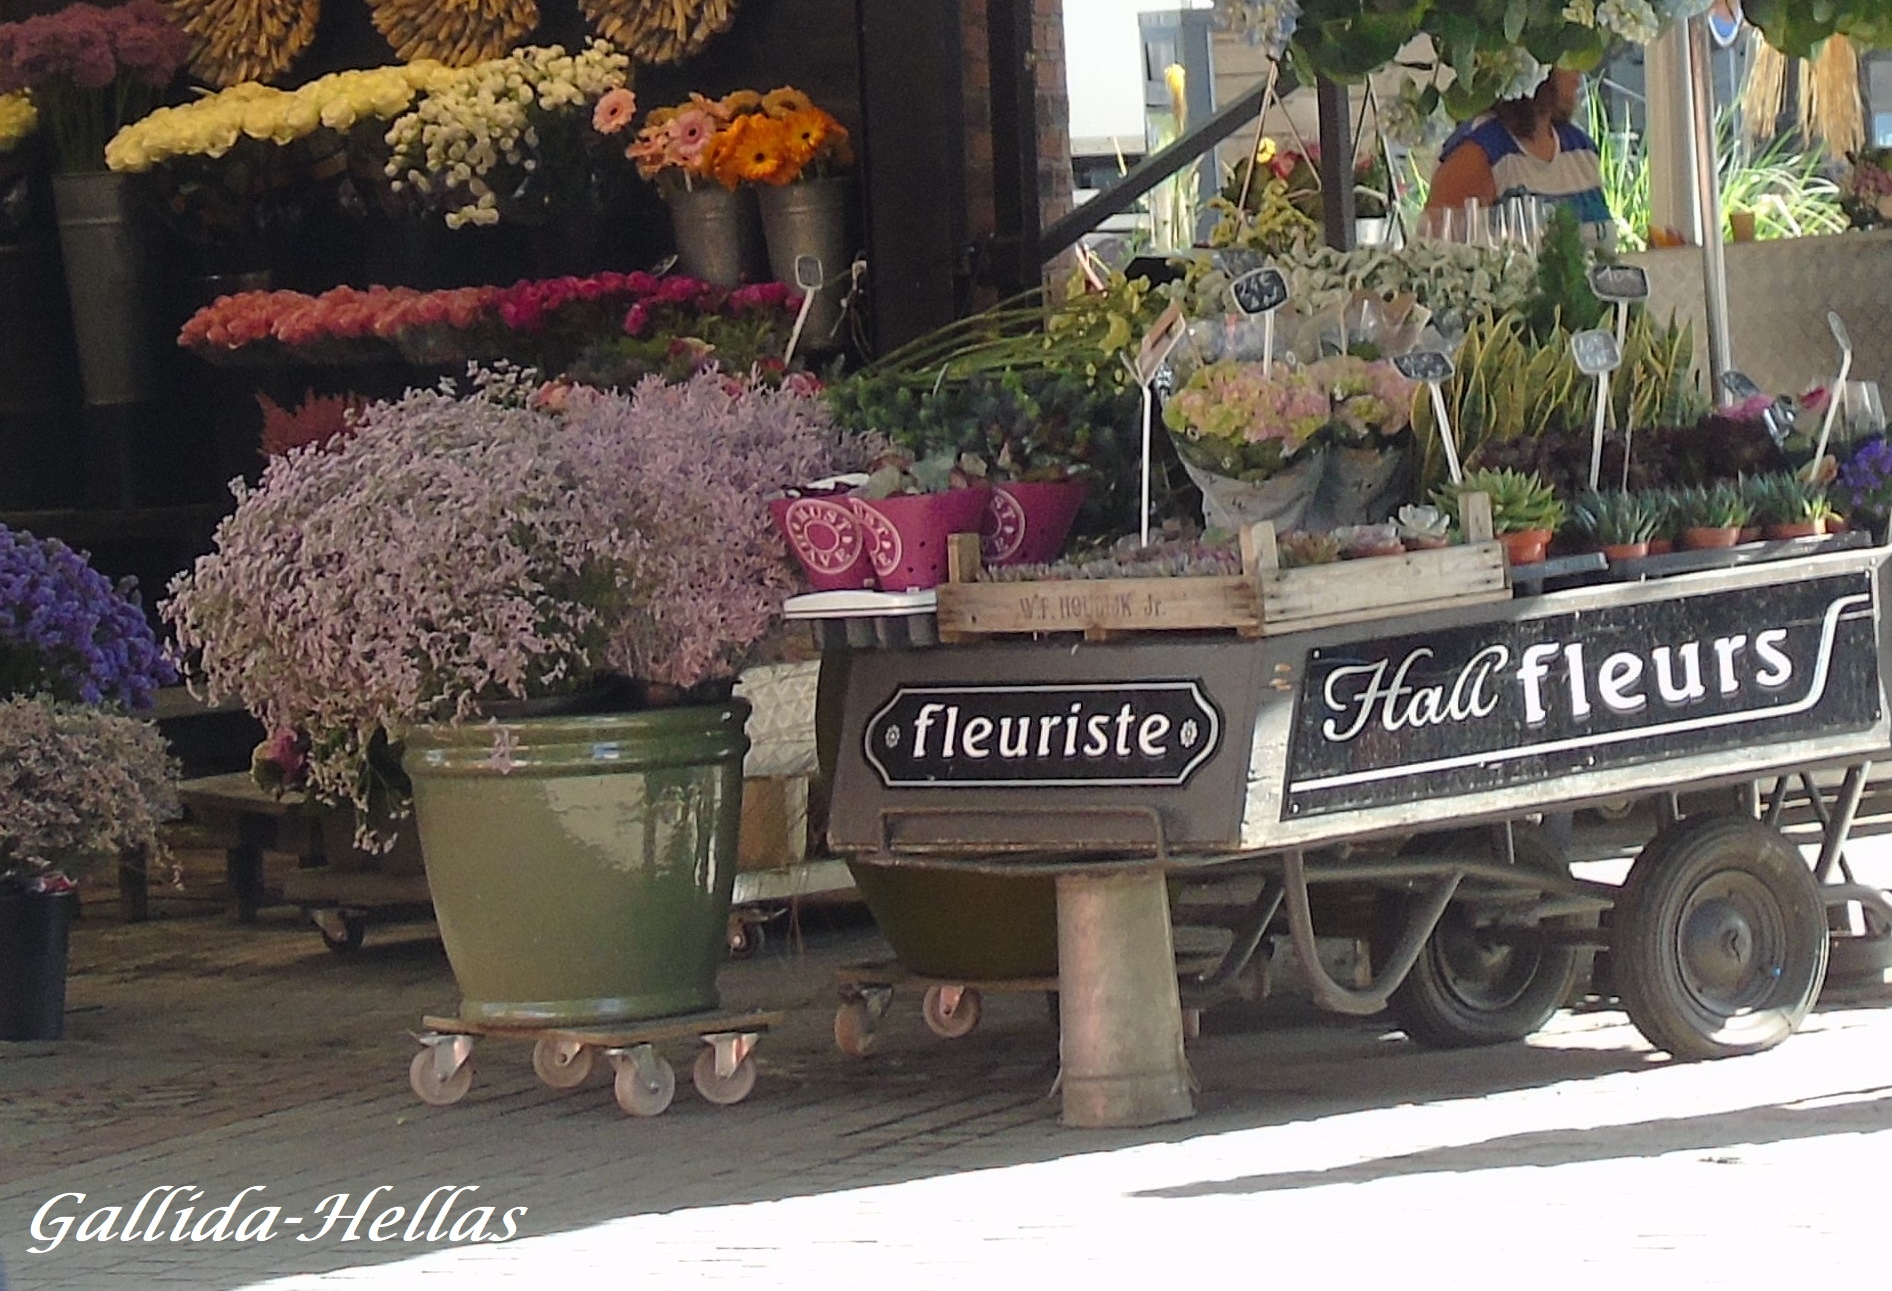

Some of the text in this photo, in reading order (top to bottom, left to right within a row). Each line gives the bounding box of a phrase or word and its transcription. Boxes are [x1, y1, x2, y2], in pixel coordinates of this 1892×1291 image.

[794, 506, 852, 531] MUST
[1323, 627, 1793, 742] Hall fleurs
[912, 703, 1171, 759] fleuriste
